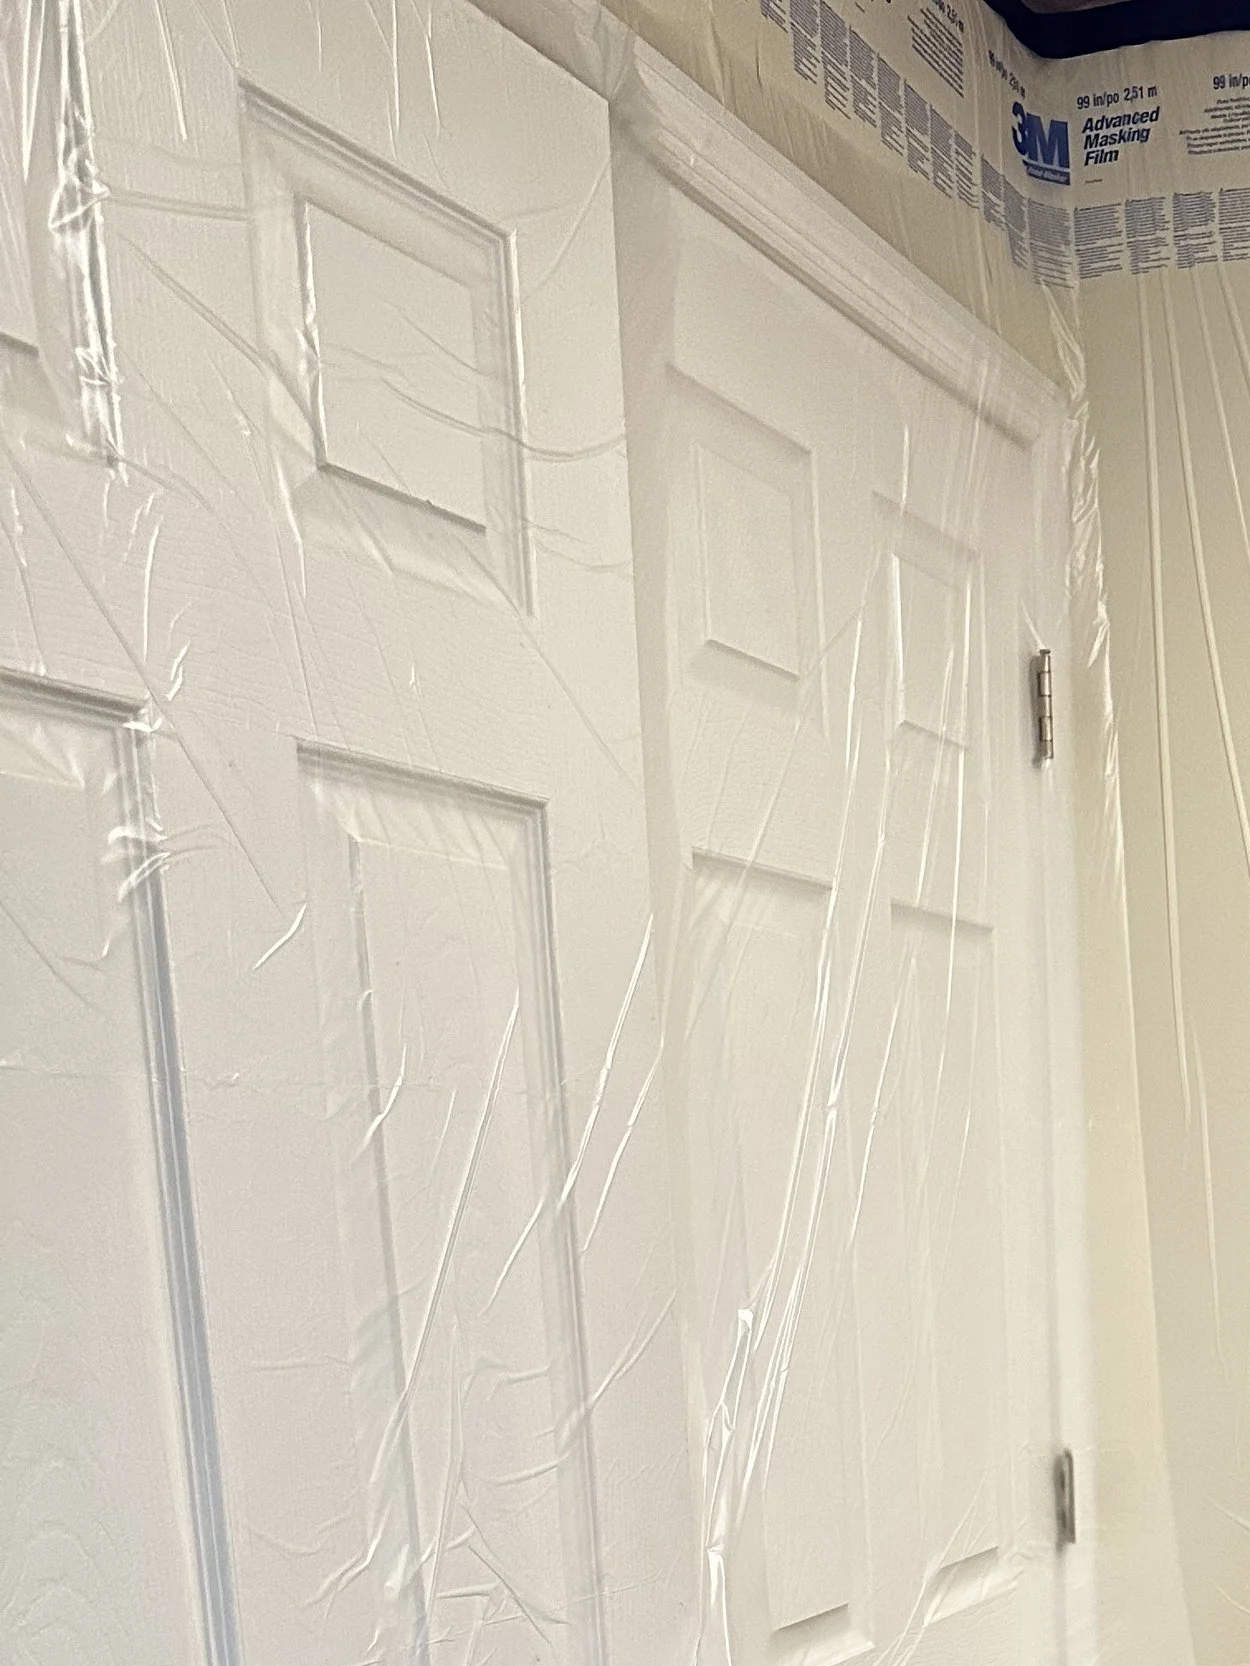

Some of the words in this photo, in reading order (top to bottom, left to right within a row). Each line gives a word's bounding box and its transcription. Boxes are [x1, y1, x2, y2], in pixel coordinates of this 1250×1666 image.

[1213, 76, 1226, 90] 99
[1077, 96, 1090, 109] 99
[1094, 92, 1120, 108] in/po
[1124, 86, 1144, 103] 2,51
[1148, 86, 1157, 98] m
[1082, 106, 1160, 133] Advanced
[1012, 101, 1069, 169] 3M
[1084, 126, 1150, 150] Masking
[1084, 149, 1119, 166] Film
